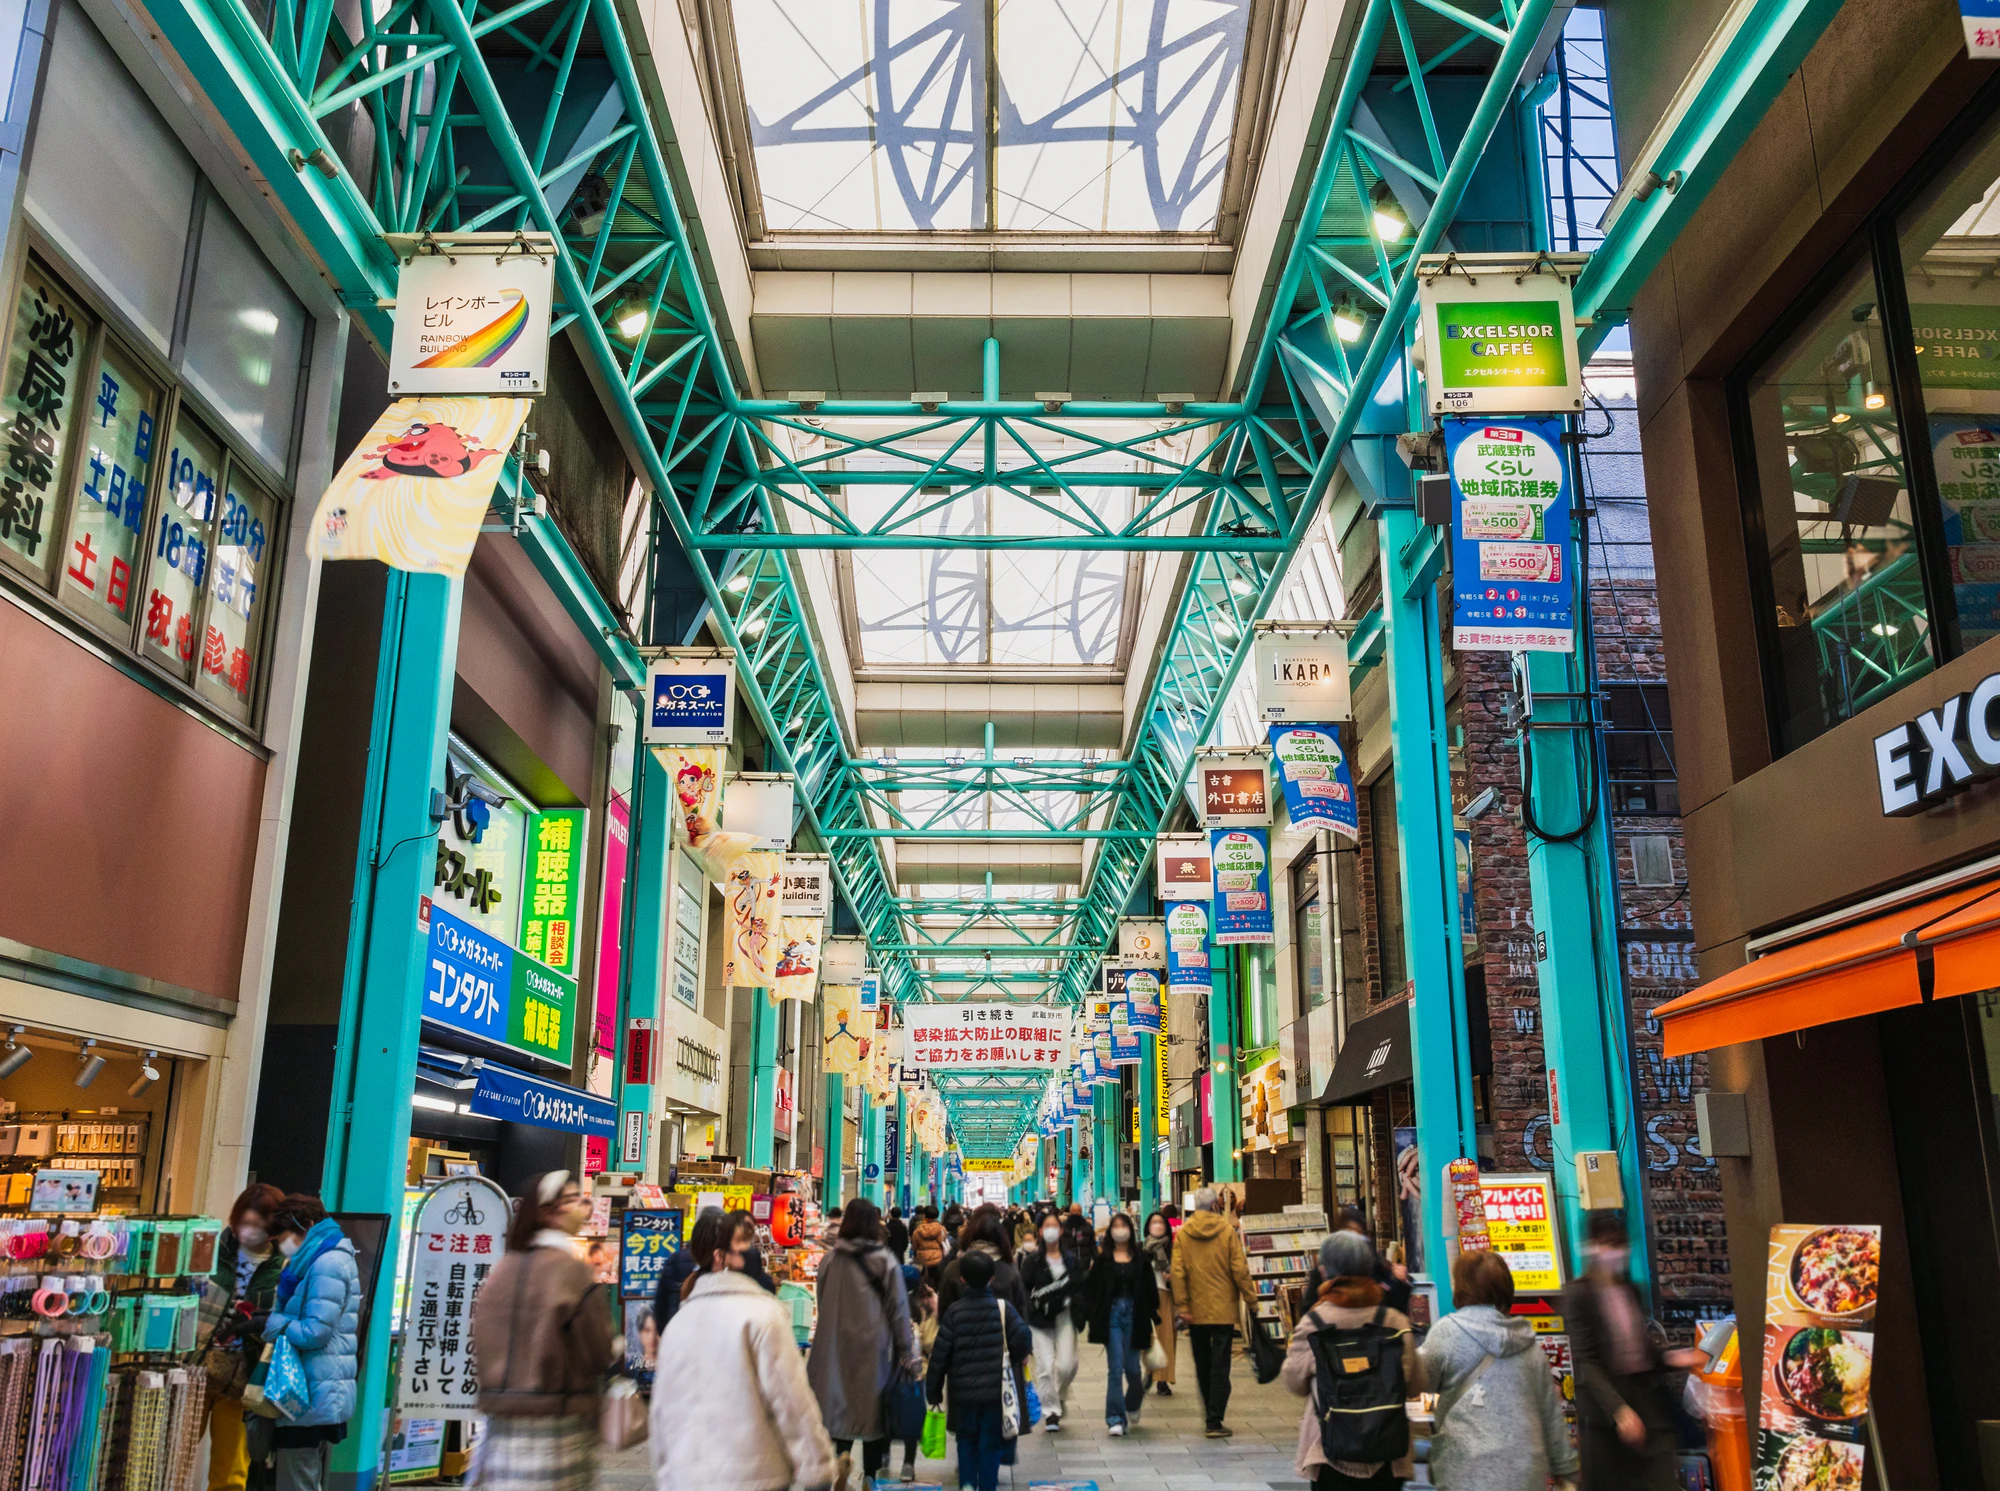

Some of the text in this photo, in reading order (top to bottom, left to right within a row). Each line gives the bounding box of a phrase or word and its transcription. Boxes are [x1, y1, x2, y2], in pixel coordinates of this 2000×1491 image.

[426, 297, 500, 310] レインボー
[423, 314, 454, 328] ビル
[420, 334, 469, 342] RAINBOW
[1446, 324, 1554, 339] EXCELSIOR
[419, 345, 468, 353] BUILDING
[1470, 340, 1534, 357] CAFFÉ
[1464, 367, 1546, 377] エクセルシオール カフェ
[507, 379, 523, 387] 111
[1451, 399, 1468, 407] 106
[0, 285, 74, 557] 泌尿器科
[1477, 444, 1536, 457] 武蔵野市
[1485, 460, 1533, 476] くらし
[1460, 479, 1559, 498] 地域応援券
[1482, 517, 1519, 528] ¥500
[1500, 558, 1536, 568] ¥500
[1458, 633, 1567, 645] お買物は地元商店会で
[1273, 663, 1332, 681] IKARA
[655, 700, 723, 710] メガネスーパー
[1281, 754, 1341, 764] 地域応援券
[1209, 775, 1233, 786] 古書
[1207, 791, 1264, 805] 外口書店
[1228, 852, 1252, 860] くらし
[533, 818, 572, 916] 補聴器
[1216, 863, 1263, 871] 地域応援券
[783, 876, 820, 889] 小美濃
[549, 922, 566, 965] 相談会
[458, 936, 503, 972] メガネスーパー
[429, 959, 500, 1025] コンタクト
[962, 1009, 1014, 1021] 引き続き
[523, 996, 562, 1050] 補聴器
[913, 1027, 1062, 1042] 感染拡大防止の取組に
[914, 1047, 1061, 1062] ご協力をお願いします
[1159, 1004, 1170, 1119] Matsumoto Kiyoshi
[544, 1097, 589, 1127] メガネスーパー
[1481, 1188, 1543, 1203] アルバイト
[633, 1216, 675, 1231] コンタクト
[428, 1233, 492, 1254] ご注意
[626, 1233, 679, 1254] 今すぐ
[437, 1262, 466, 1395] 自転車は押して
[411, 1281, 440, 1394] ご通行下さい
[1762, 1333, 1776, 1382] Rice
[1757, 1392, 1773, 1460] Menu
